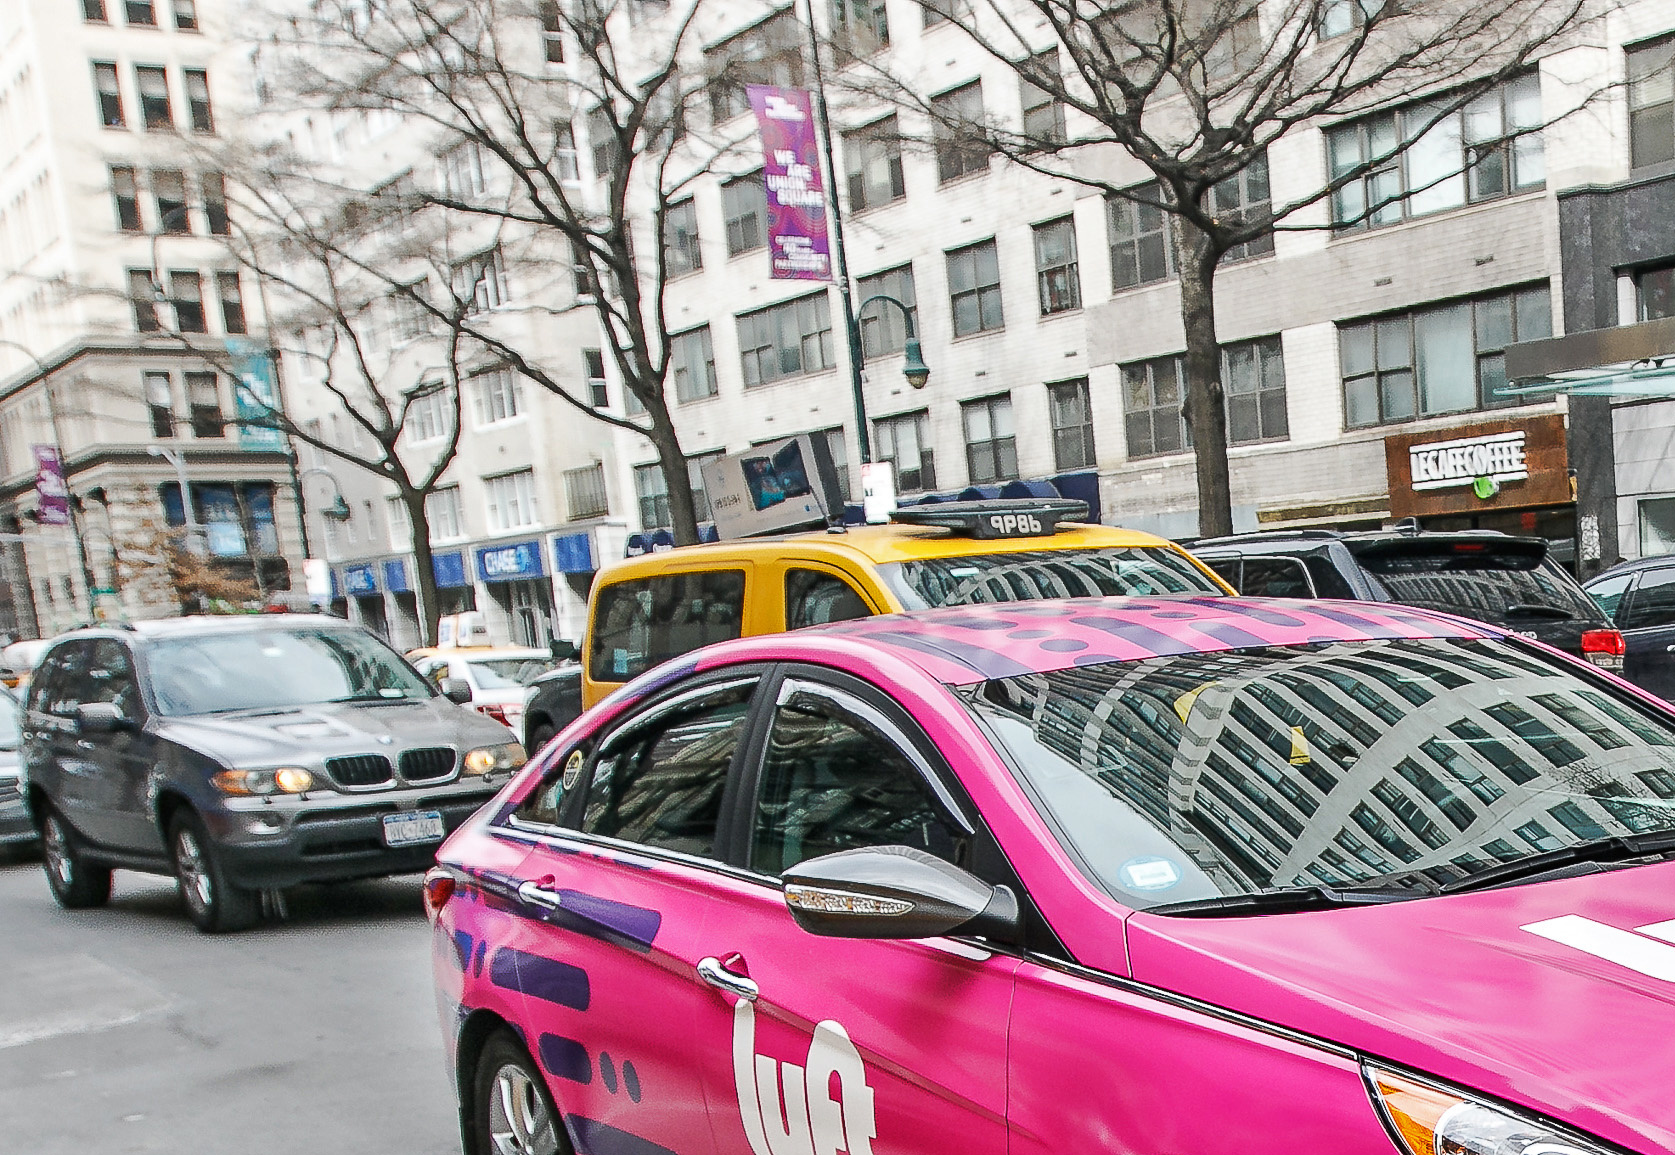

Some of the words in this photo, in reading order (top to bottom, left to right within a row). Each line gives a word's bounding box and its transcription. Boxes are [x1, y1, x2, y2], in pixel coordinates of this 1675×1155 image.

[773, 150, 796, 165] WE
[787, 163, 813, 181] ARE
[766, 174, 806, 191] UNION
[776, 189, 824, 208] SQUARE
[990, 513, 1042, 534] 9P86
[484, 549, 518, 574] CHASE
